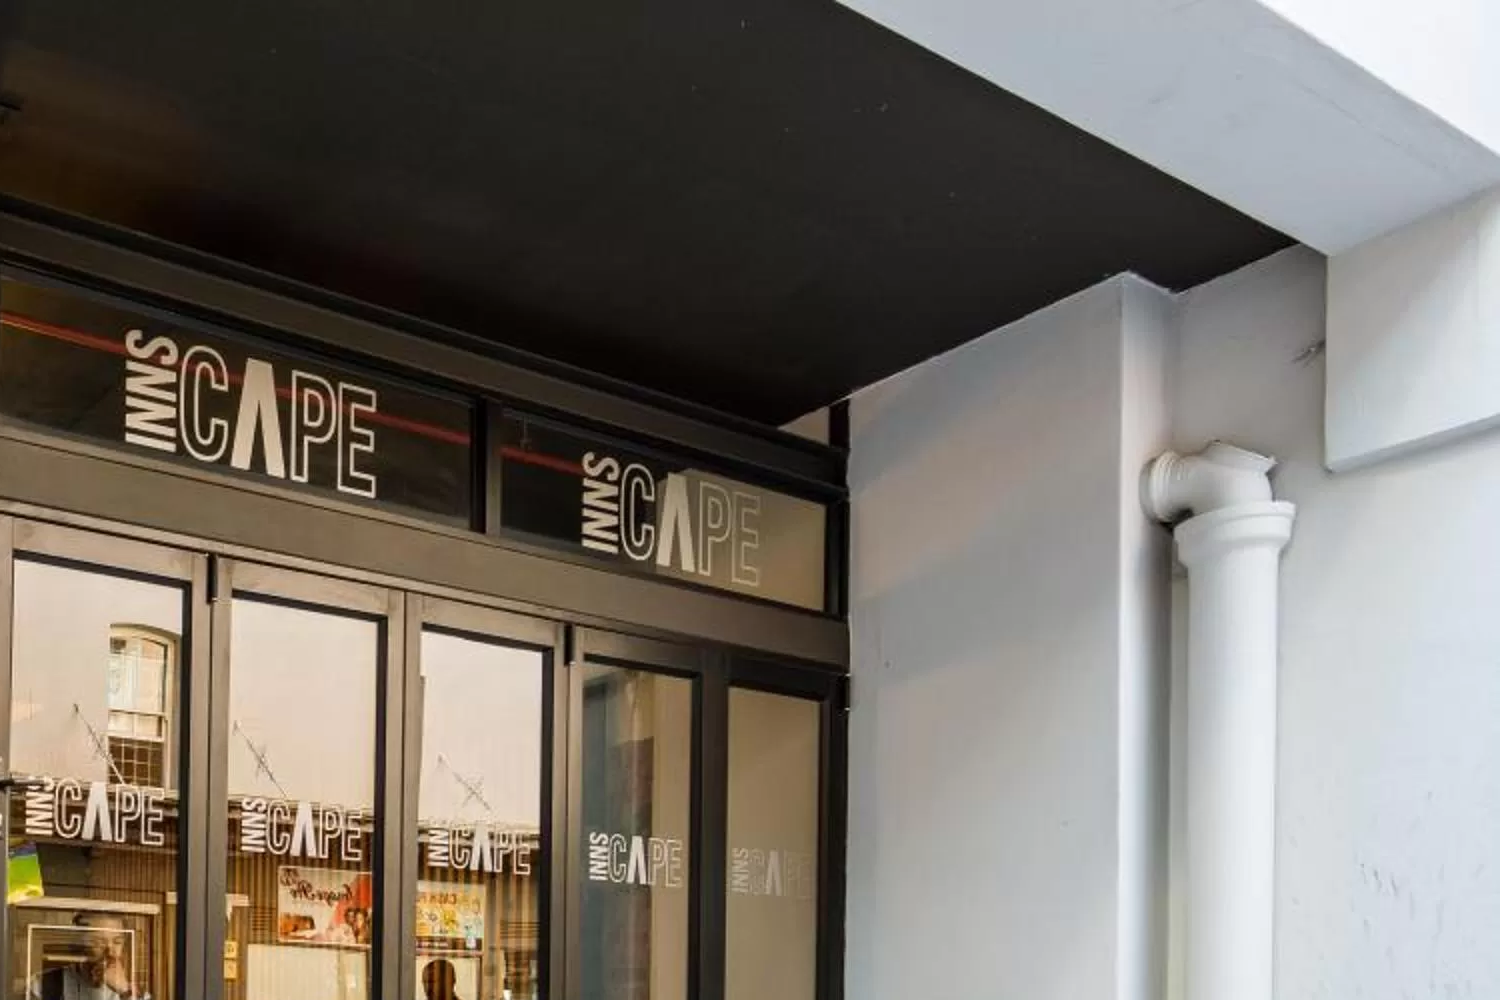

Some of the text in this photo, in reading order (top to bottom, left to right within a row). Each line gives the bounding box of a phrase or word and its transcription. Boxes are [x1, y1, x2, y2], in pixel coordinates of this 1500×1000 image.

[179, 345, 377, 499] CAPE
[620, 463, 761, 587] CAPE
[55, 777, 165, 846] CAPE
[267, 800, 363, 861] CAPE
[609, 833, 683, 887] CAPE
